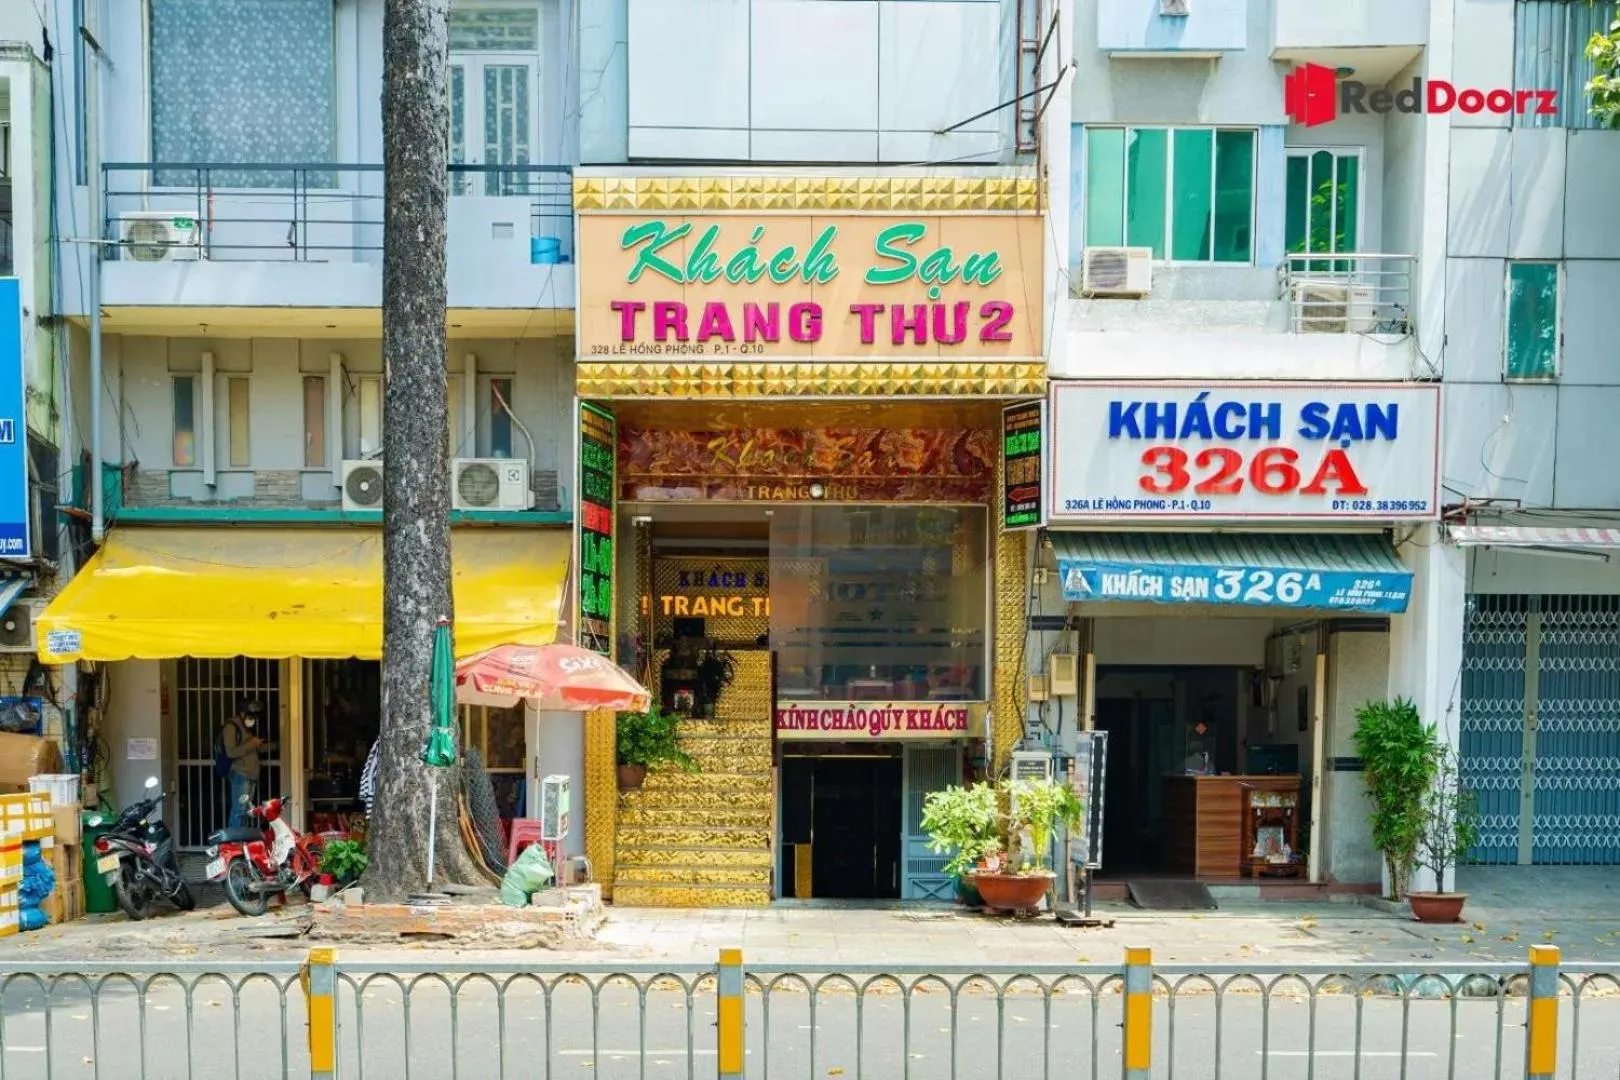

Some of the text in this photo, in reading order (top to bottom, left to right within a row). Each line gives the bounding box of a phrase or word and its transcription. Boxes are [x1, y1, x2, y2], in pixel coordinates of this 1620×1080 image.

[619, 220, 1004, 300] Khách Sạn
[610, 300, 824, 343] TRANG
[591, 345, 609, 355] 328
[1108, 392, 1399, 448] KHÁCH SẠN
[1137, 446, 1368, 496] 326A
[749, 486, 810, 499] TRANG
[1065, 499, 1090, 510] 326A
[1092, 497, 1104, 510] LÊ
[1133, 499, 1165, 510] PHONG
[1190, 499, 1211, 510] Q.10
[1101, 569, 1163, 598] KHÁCH
[1170, 575, 1209, 602] SẠN
[660, 595, 744, 617] TRANG
[776, 703, 819, 730] KÍNH
[906, 703, 969, 731] KHÁCH
